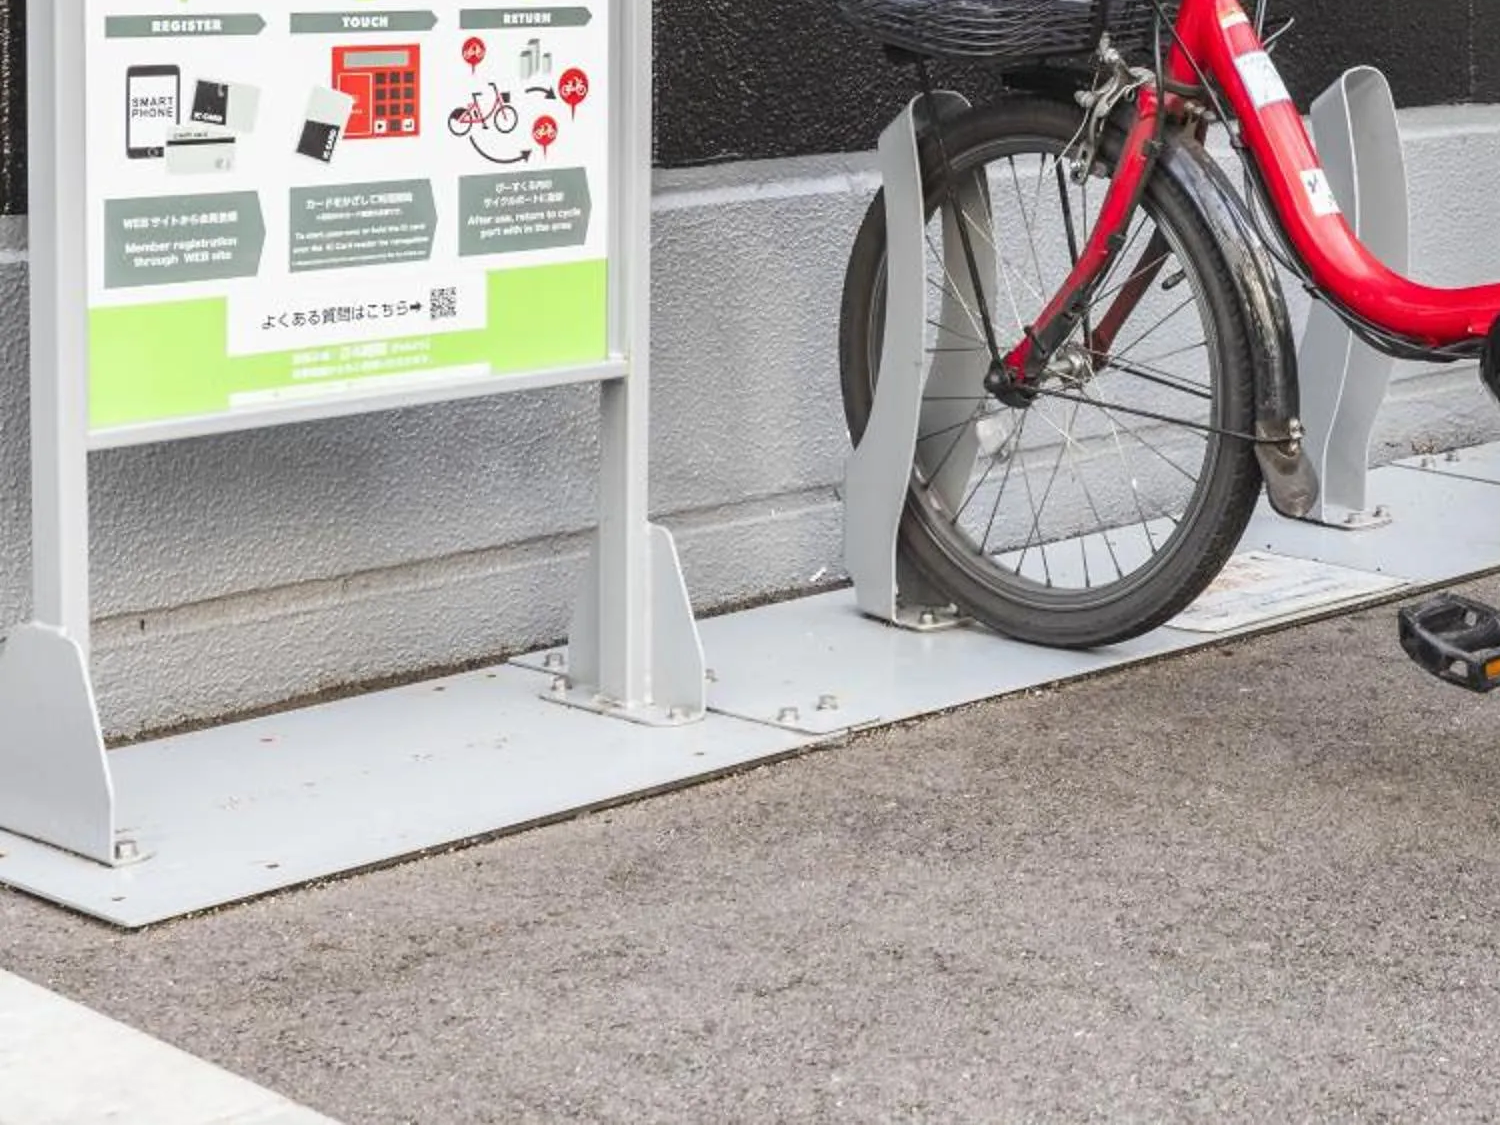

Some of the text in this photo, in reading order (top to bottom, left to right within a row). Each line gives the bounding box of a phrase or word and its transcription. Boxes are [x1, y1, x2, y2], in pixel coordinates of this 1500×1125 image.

[342, 15, 389, 28] TOUCH
[503, 12, 552, 25] RETURN
[151, 18, 223, 33] REGISTER
[131, 96, 174, 108] SMART
[131, 107, 174, 118] PHONE
[261, 300, 410, 331] よくある質問はこちら
